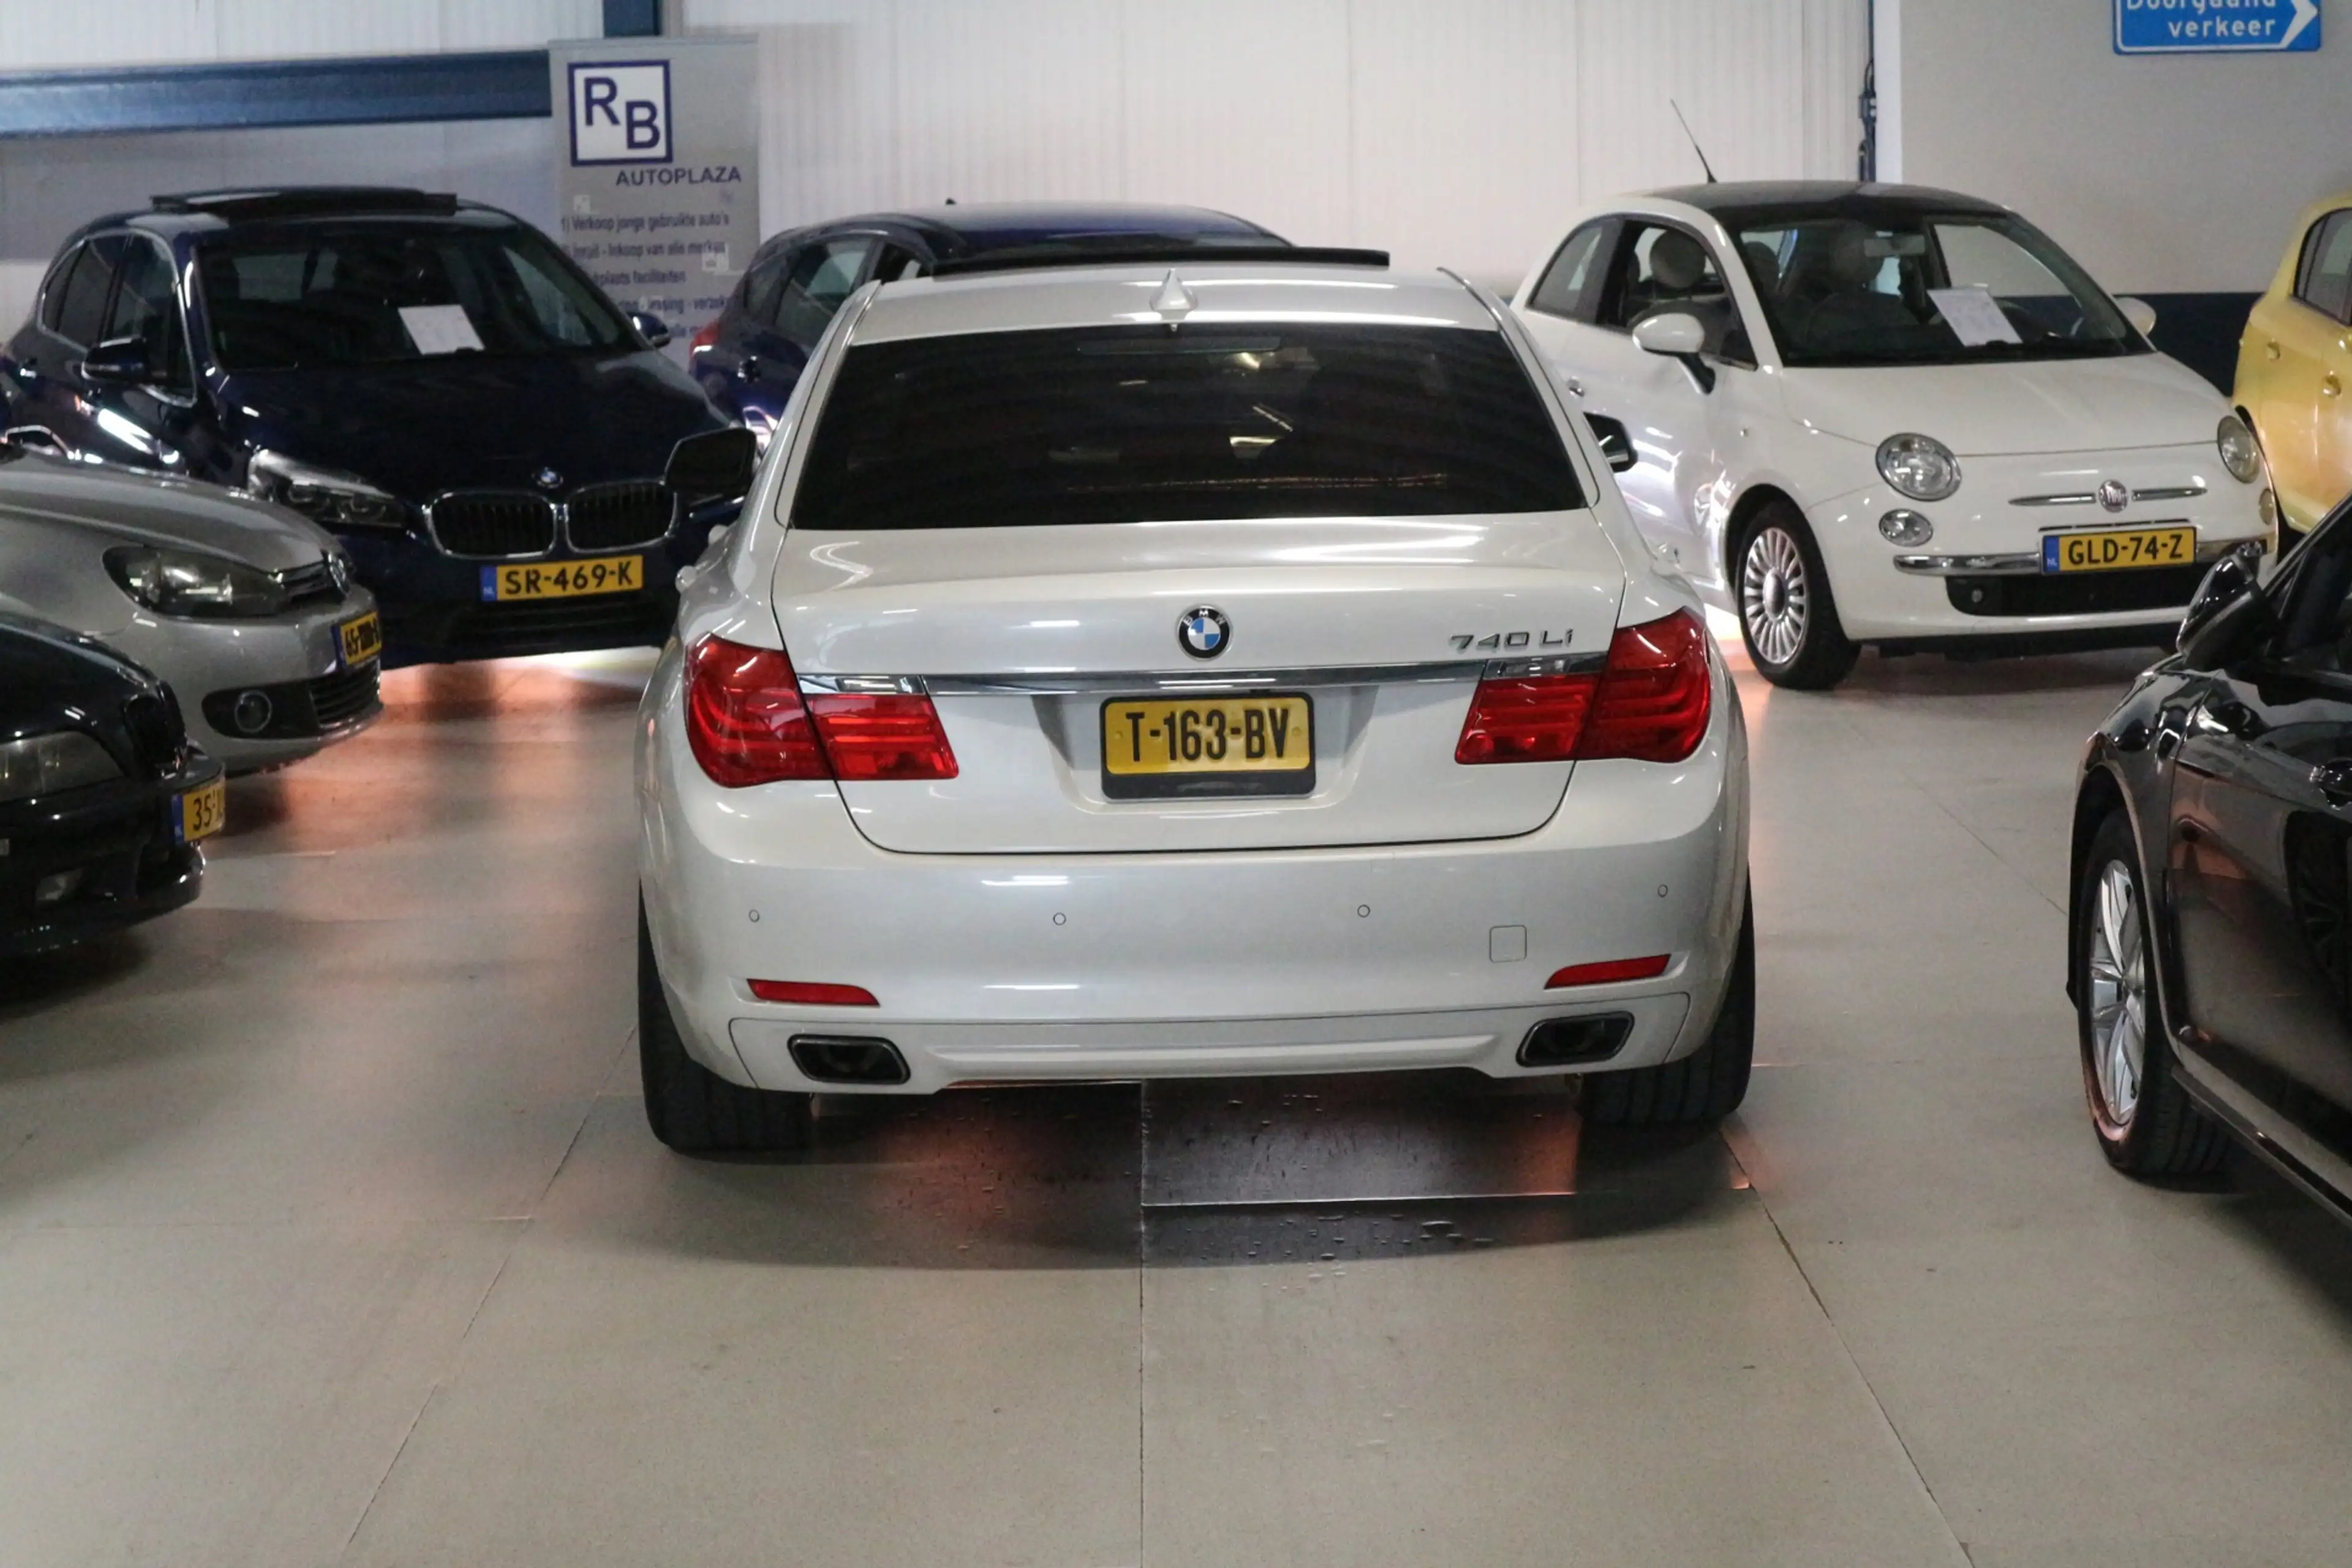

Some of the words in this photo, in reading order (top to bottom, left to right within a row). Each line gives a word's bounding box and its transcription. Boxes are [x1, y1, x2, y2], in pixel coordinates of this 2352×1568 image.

[2168, 15, 2276, 38] verkeer
[616, 166, 742, 186] AUTOPLAZA
[2068, 534, 2183, 565] GLD-74-Z
[505, 560, 633, 595] SR-469-K
[1125, 707, 1289, 762] T-163-BV
